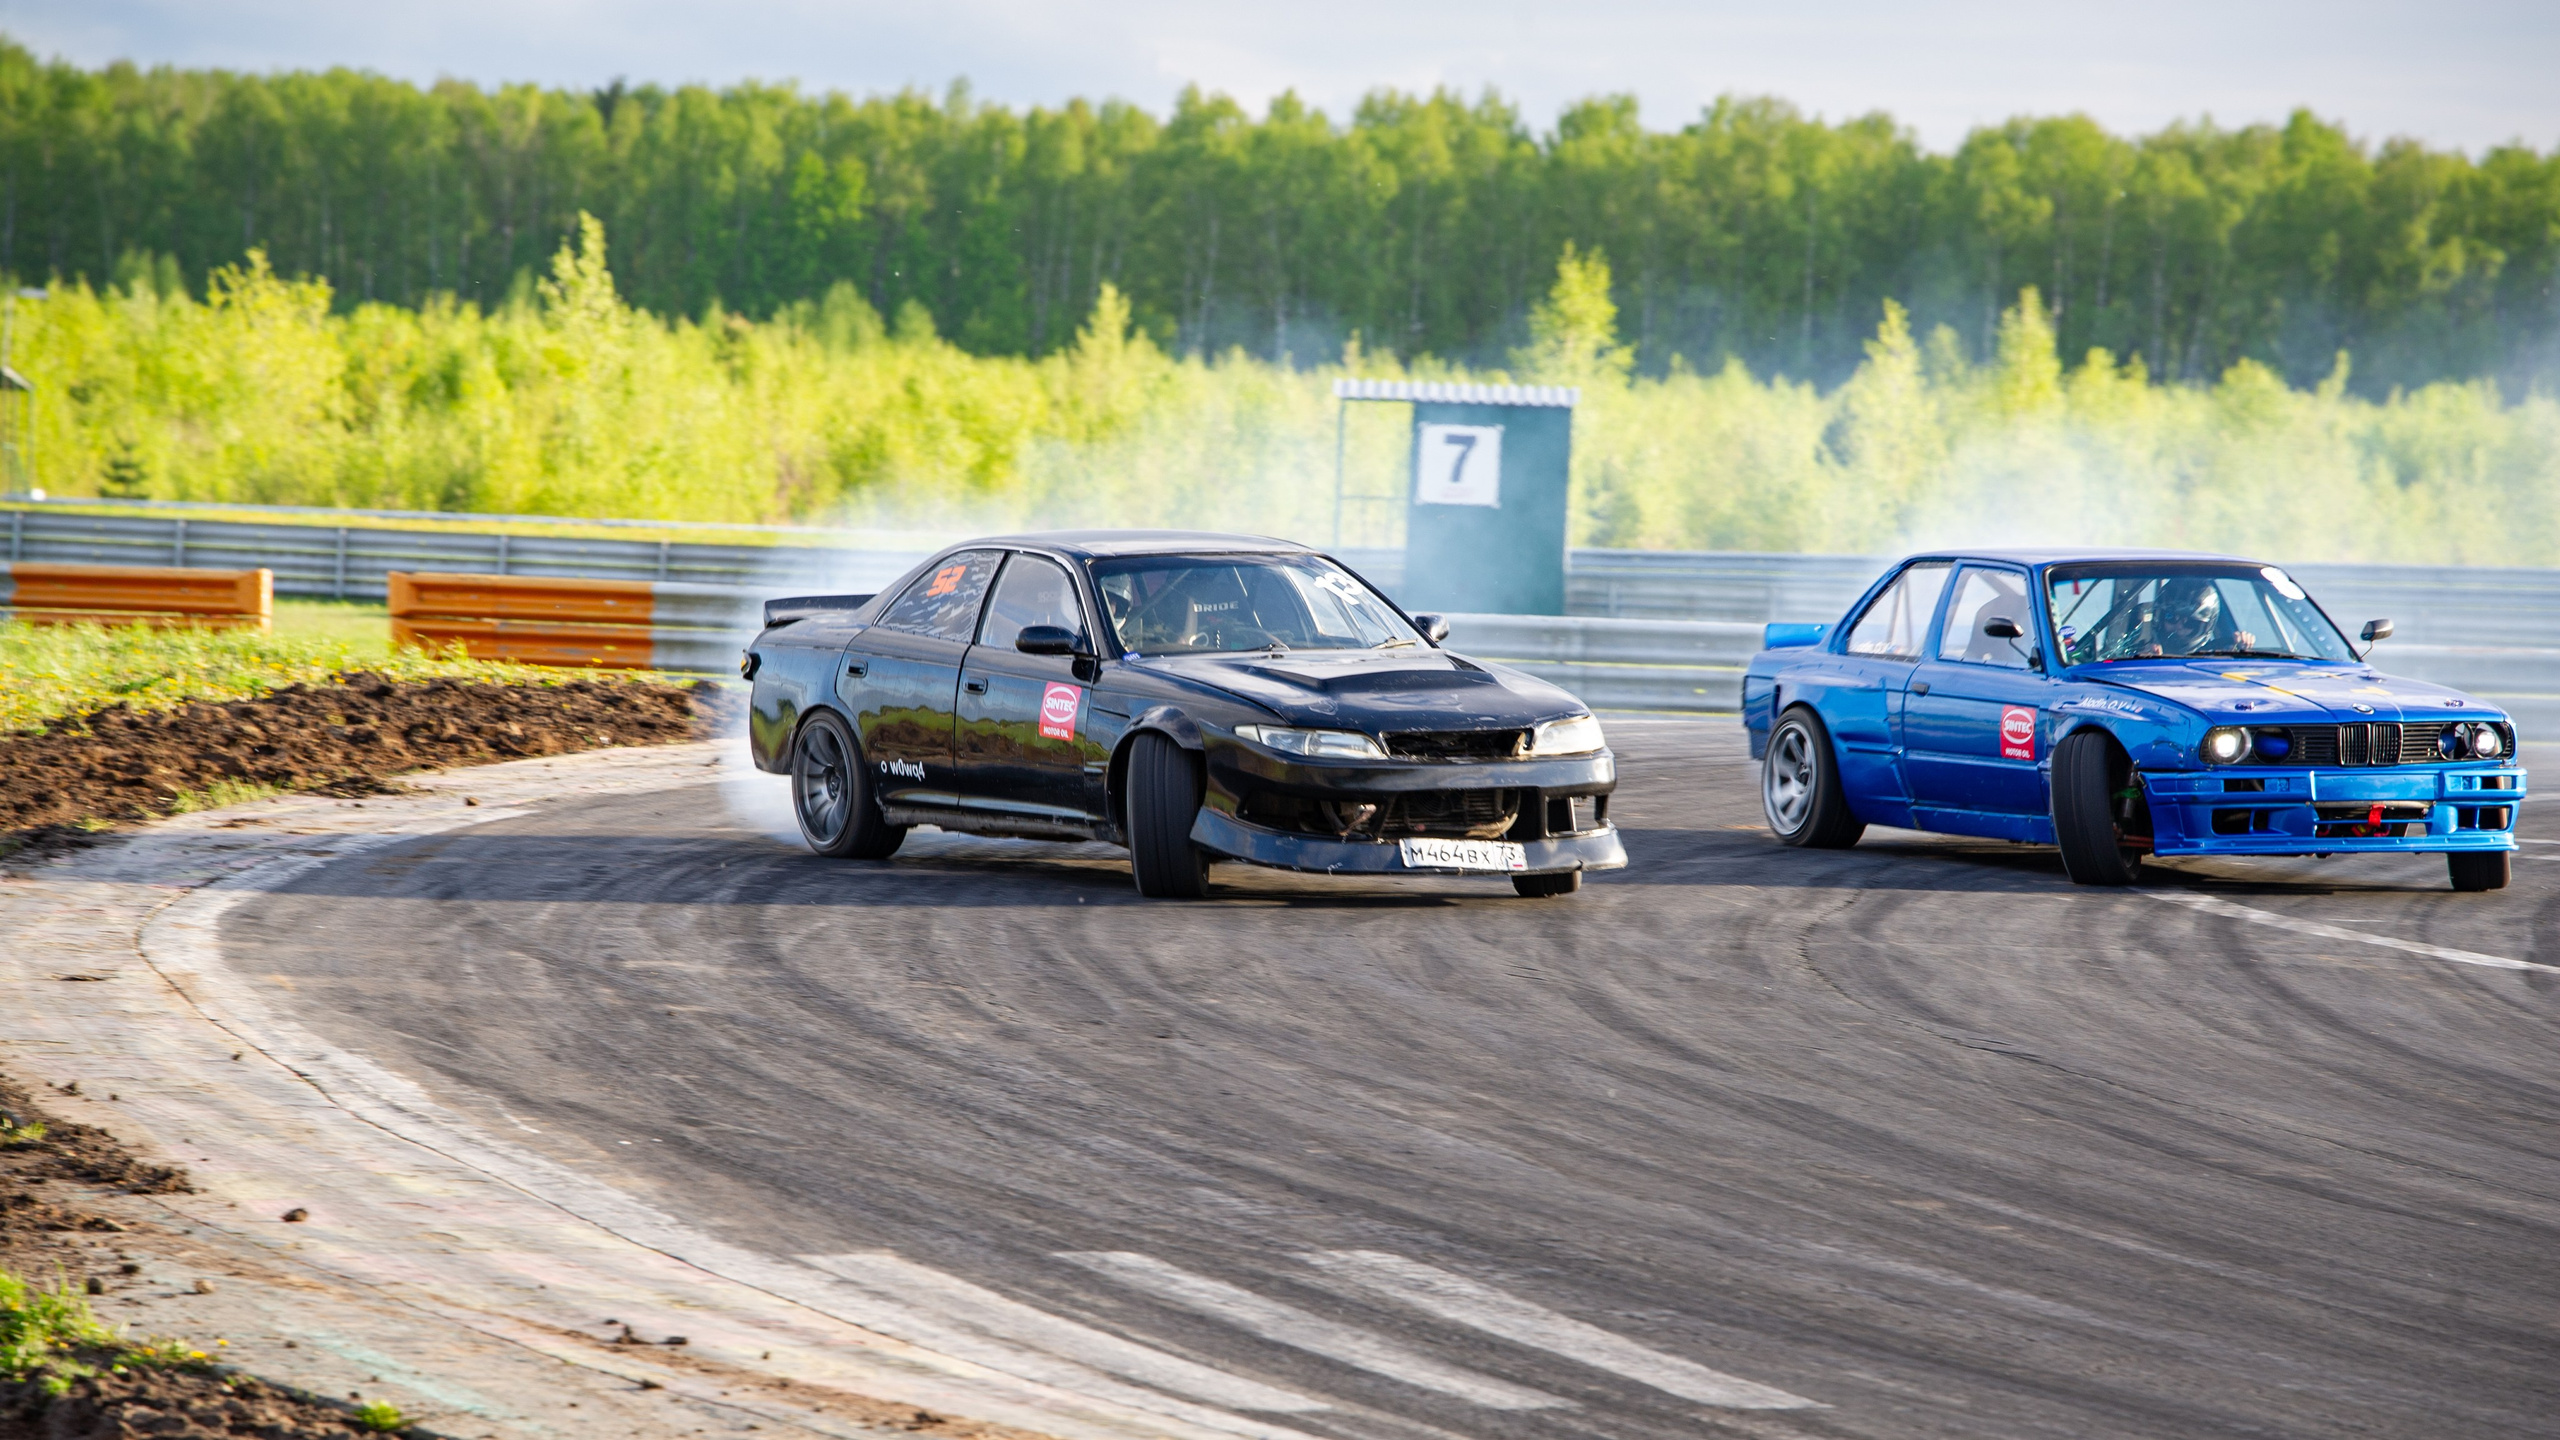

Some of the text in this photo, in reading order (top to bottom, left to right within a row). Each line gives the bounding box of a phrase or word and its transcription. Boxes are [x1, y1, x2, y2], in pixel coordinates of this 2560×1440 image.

[1445, 433, 1477, 482] 7
[927, 565, 967, 597] 52
[1193, 601, 1239, 612] BRIDE
[1045, 697, 1075, 712] SINTEC
[2004, 719, 2031, 734] SINTEC
